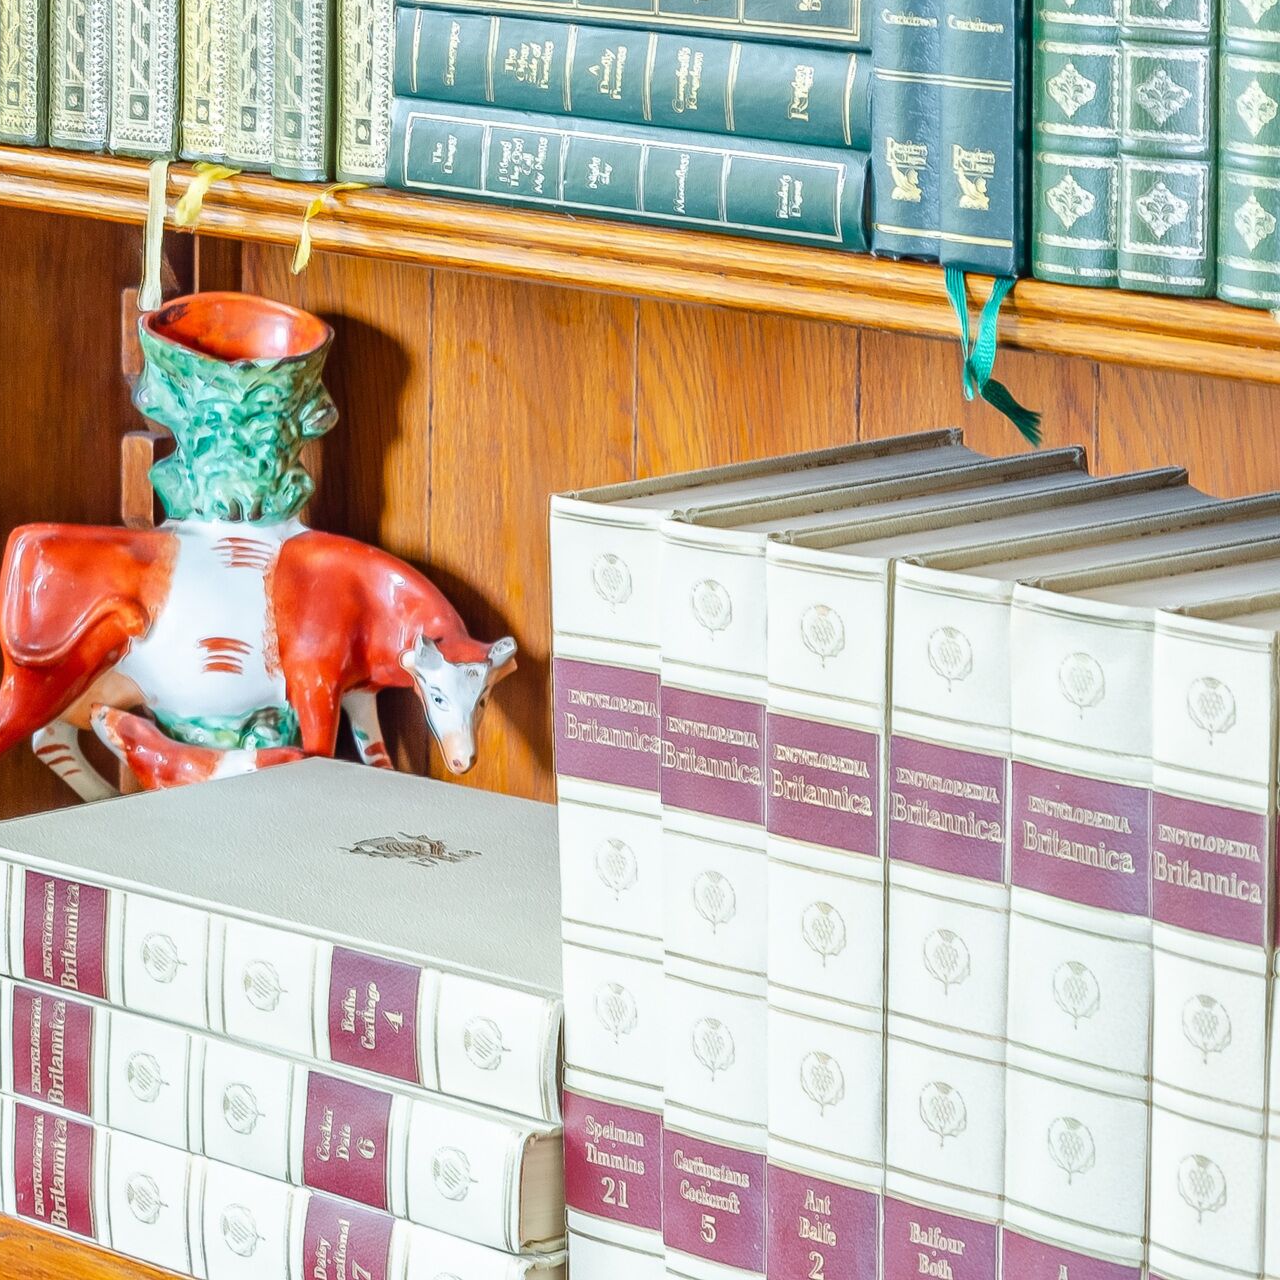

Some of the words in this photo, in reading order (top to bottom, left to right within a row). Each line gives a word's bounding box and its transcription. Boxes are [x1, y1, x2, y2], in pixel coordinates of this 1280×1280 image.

[504, 47, 518, 74] The
[685, 51, 705, 111] Kingdom
[775, 173, 792, 220] Reader's
[788, 178, 804, 219] Digest
[563, 712, 662, 755] Britannica
[661, 740, 763, 787] Britannica
[769, 768, 873, 817] Britannica
[890, 791, 1004, 844] Britannica
[1022, 820, 1136, 874] Britannica
[1152, 849, 1263, 905] Britannica
[60, 882, 80, 991] Britannica
[340, 987, 358, 1035] Botha
[360, 981, 381, 1051] Carthage
[382, 1008, 405, 1035] 4
[47, 999, 67, 1108] Britannica
[316, 1106, 335, 1162] Cocker
[356, 1136, 376, 1161] 6
[584, 1114, 646, 1148] Spelman
[50, 1117, 68, 1230] Britannica
[584, 1141, 646, 1176] Timmins
[672, 1149, 751, 1189] Carthusians
[600, 1176, 630, 1210] 21
[679, 1178, 742, 1215] Cockcroft
[803, 1189, 832, 1216] Ant
[333, 1218, 351, 1280] cational
[699, 1214, 717, 1245] 5
[798, 1216, 838, 1248] Balfe
[908, 1221, 966, 1257] Balfour
[808, 1251, 826, 1280] 2
[917, 1252, 954, 1280] Both
